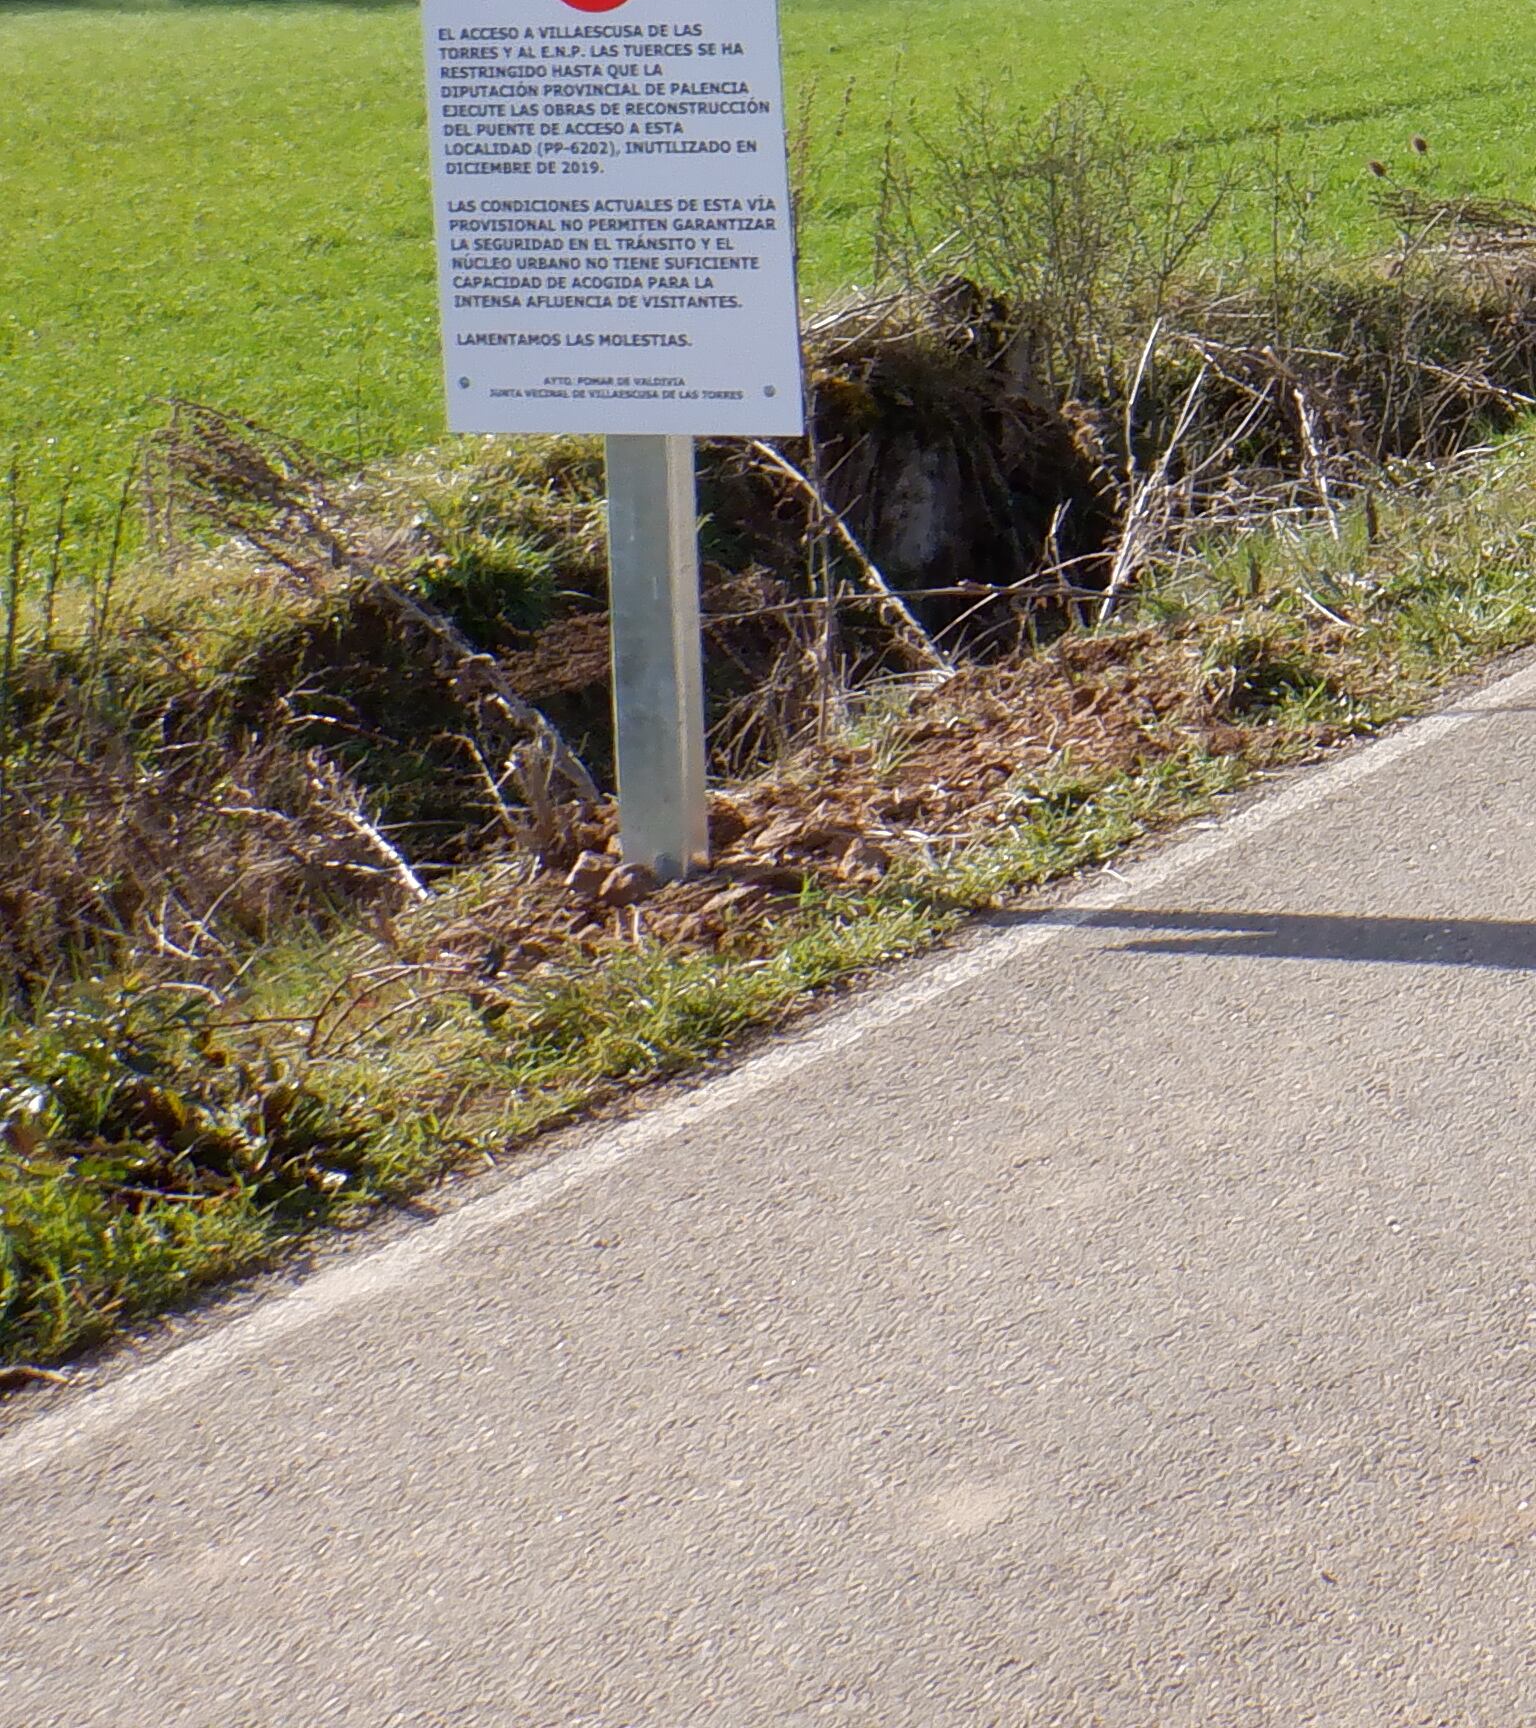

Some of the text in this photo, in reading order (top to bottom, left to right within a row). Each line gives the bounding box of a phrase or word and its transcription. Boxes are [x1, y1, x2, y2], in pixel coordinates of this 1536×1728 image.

[439, 25, 702, 41] EL ACCESO A VILLAESCUSA DE LAS
[439, 43, 744, 60] TORRES Y AL E.N.P. LAS TUERCES SE HA
[440, 63, 662, 79] RESTRINGIDO HASTA QUE LA
[441, 82, 749, 98] DIPUTACIÓN PROVINCIAL DE PALENCIA
[442, 98, 770, 118] EJECUTE LAS OBRAS DE RECONSTRUCCIÓN
[443, 122, 684, 137] DEL PUENTE DE ACCESO A ESTA
[445, 141, 758, 156] LOCALIDAD (PP-6202), INUTILIZADO EN
[446, 161, 605, 175] DICIEMBRE DE 2019.
[448, 196, 776, 213] LAS CONDICIONES ACTUALES DE ESTA VÍA
[449, 218, 776, 232] PROVISIONAL NO PERMITEN GARANTIZAR
[451, 235, 734, 251] LA SEGURIDAD EN EL TRÁNSITO Y EL
[452, 254, 760, 270] NÚCLEO URBANO NO TIENE SUFICIENTE
[453, 276, 713, 289] CAPACIDAD DE ACOGIDA PARA LA
[454, 295, 742, 308] INTENSA AFLUENCIA DE VISITANTES.
[457, 334, 692, 346] LAMENTAMOS LAS MOLESTIAS.
[617, 378, 631, 386] DE
[573, 390, 586, 399] DE
[589, 390, 658, 399] VILLAESCUSA
[662, 390, 676, 399] DE
[678, 390, 699, 399] LAS
[702, 390, 743, 399] TORRES
